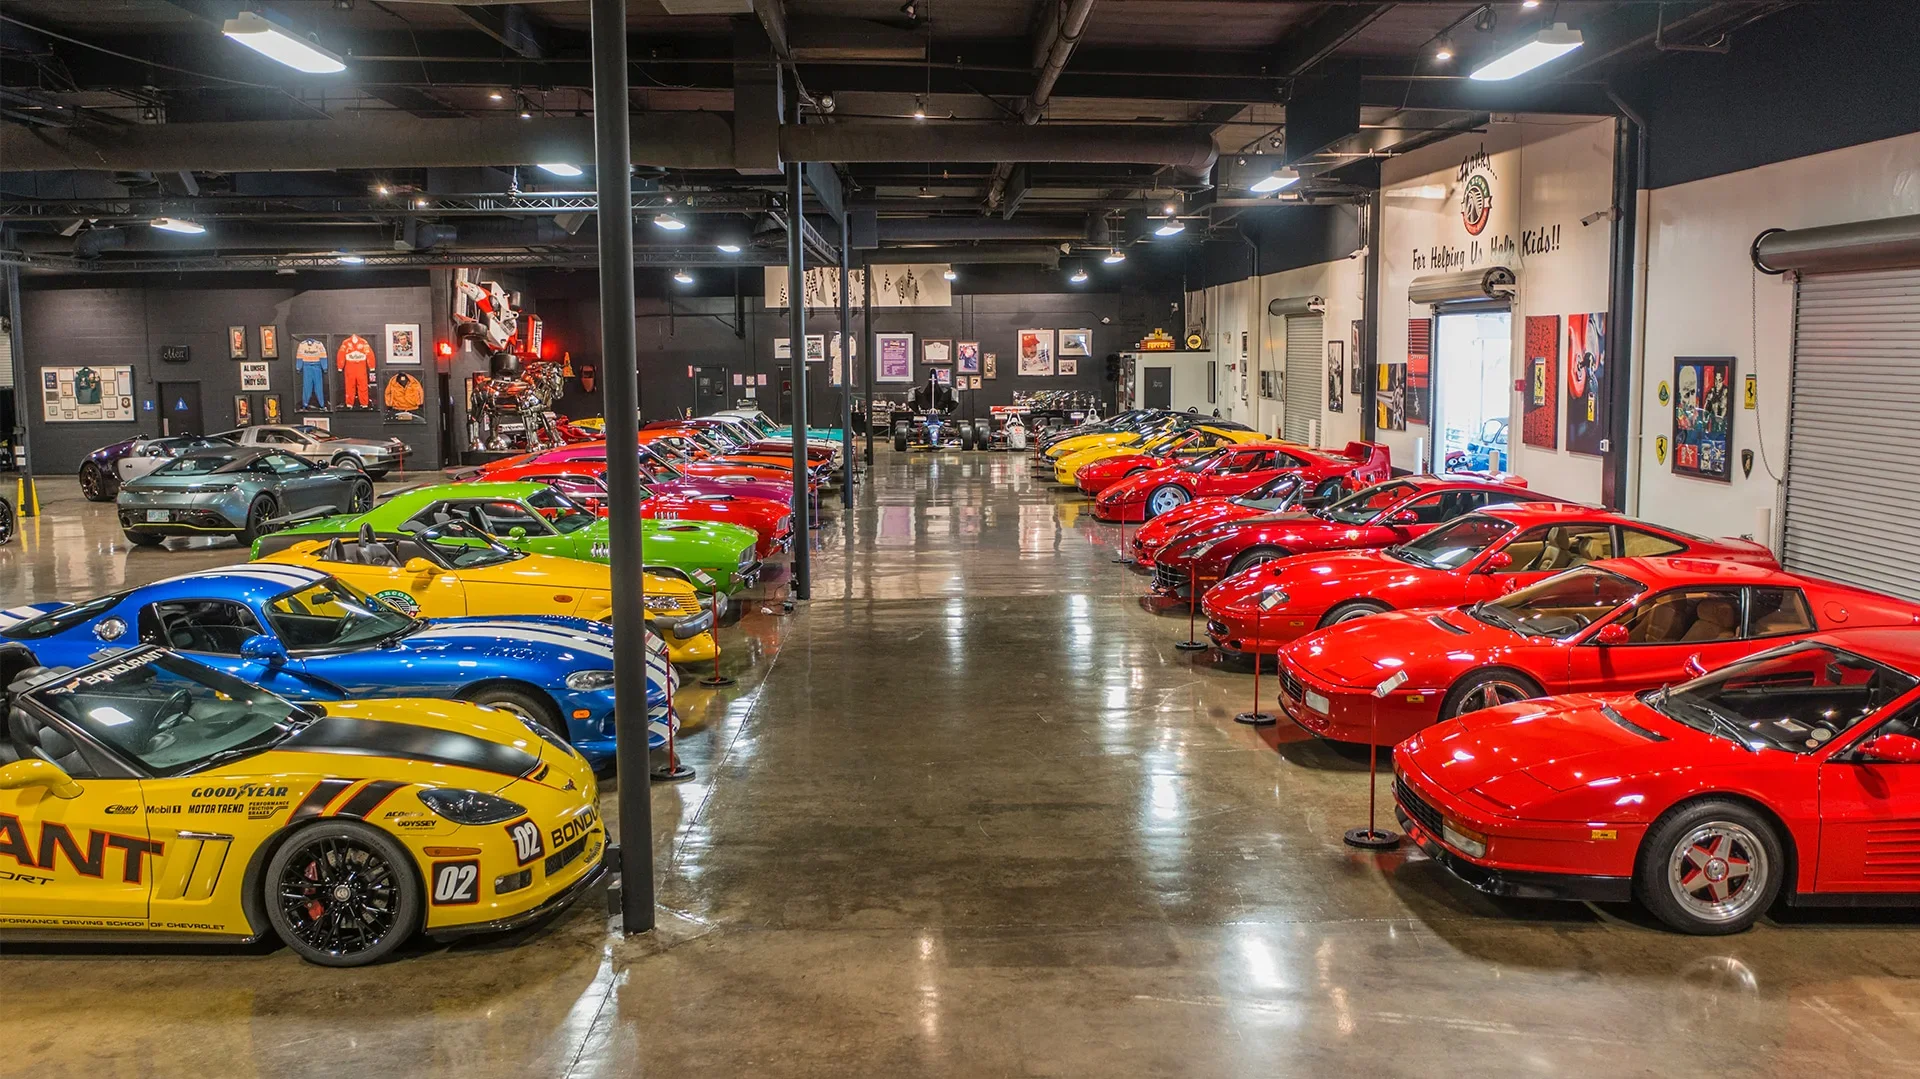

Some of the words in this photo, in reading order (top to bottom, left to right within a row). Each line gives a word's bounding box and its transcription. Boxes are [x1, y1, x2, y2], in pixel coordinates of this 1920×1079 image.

[1413, 249, 1426, 271] For
[1430, 246, 1465, 273] Helping
[1470, 241, 1483, 264] Us
[1490, 235, 1515, 266] Help
[1522, 224, 1561, 257] Kids!!
[81, 649, 163, 685] BONDURANT
[192, 786, 288, 798] GOODYEAR
[146, 804, 171, 814] Mobil
[172, 805, 182, 814] 1
[188, 804, 216, 814] MOTOR
[218, 804, 244, 814] TREND
[514, 821, 541, 861] 02
[434, 865, 477, 900] 02
[166, 922, 226, 931] CHEVROLET
